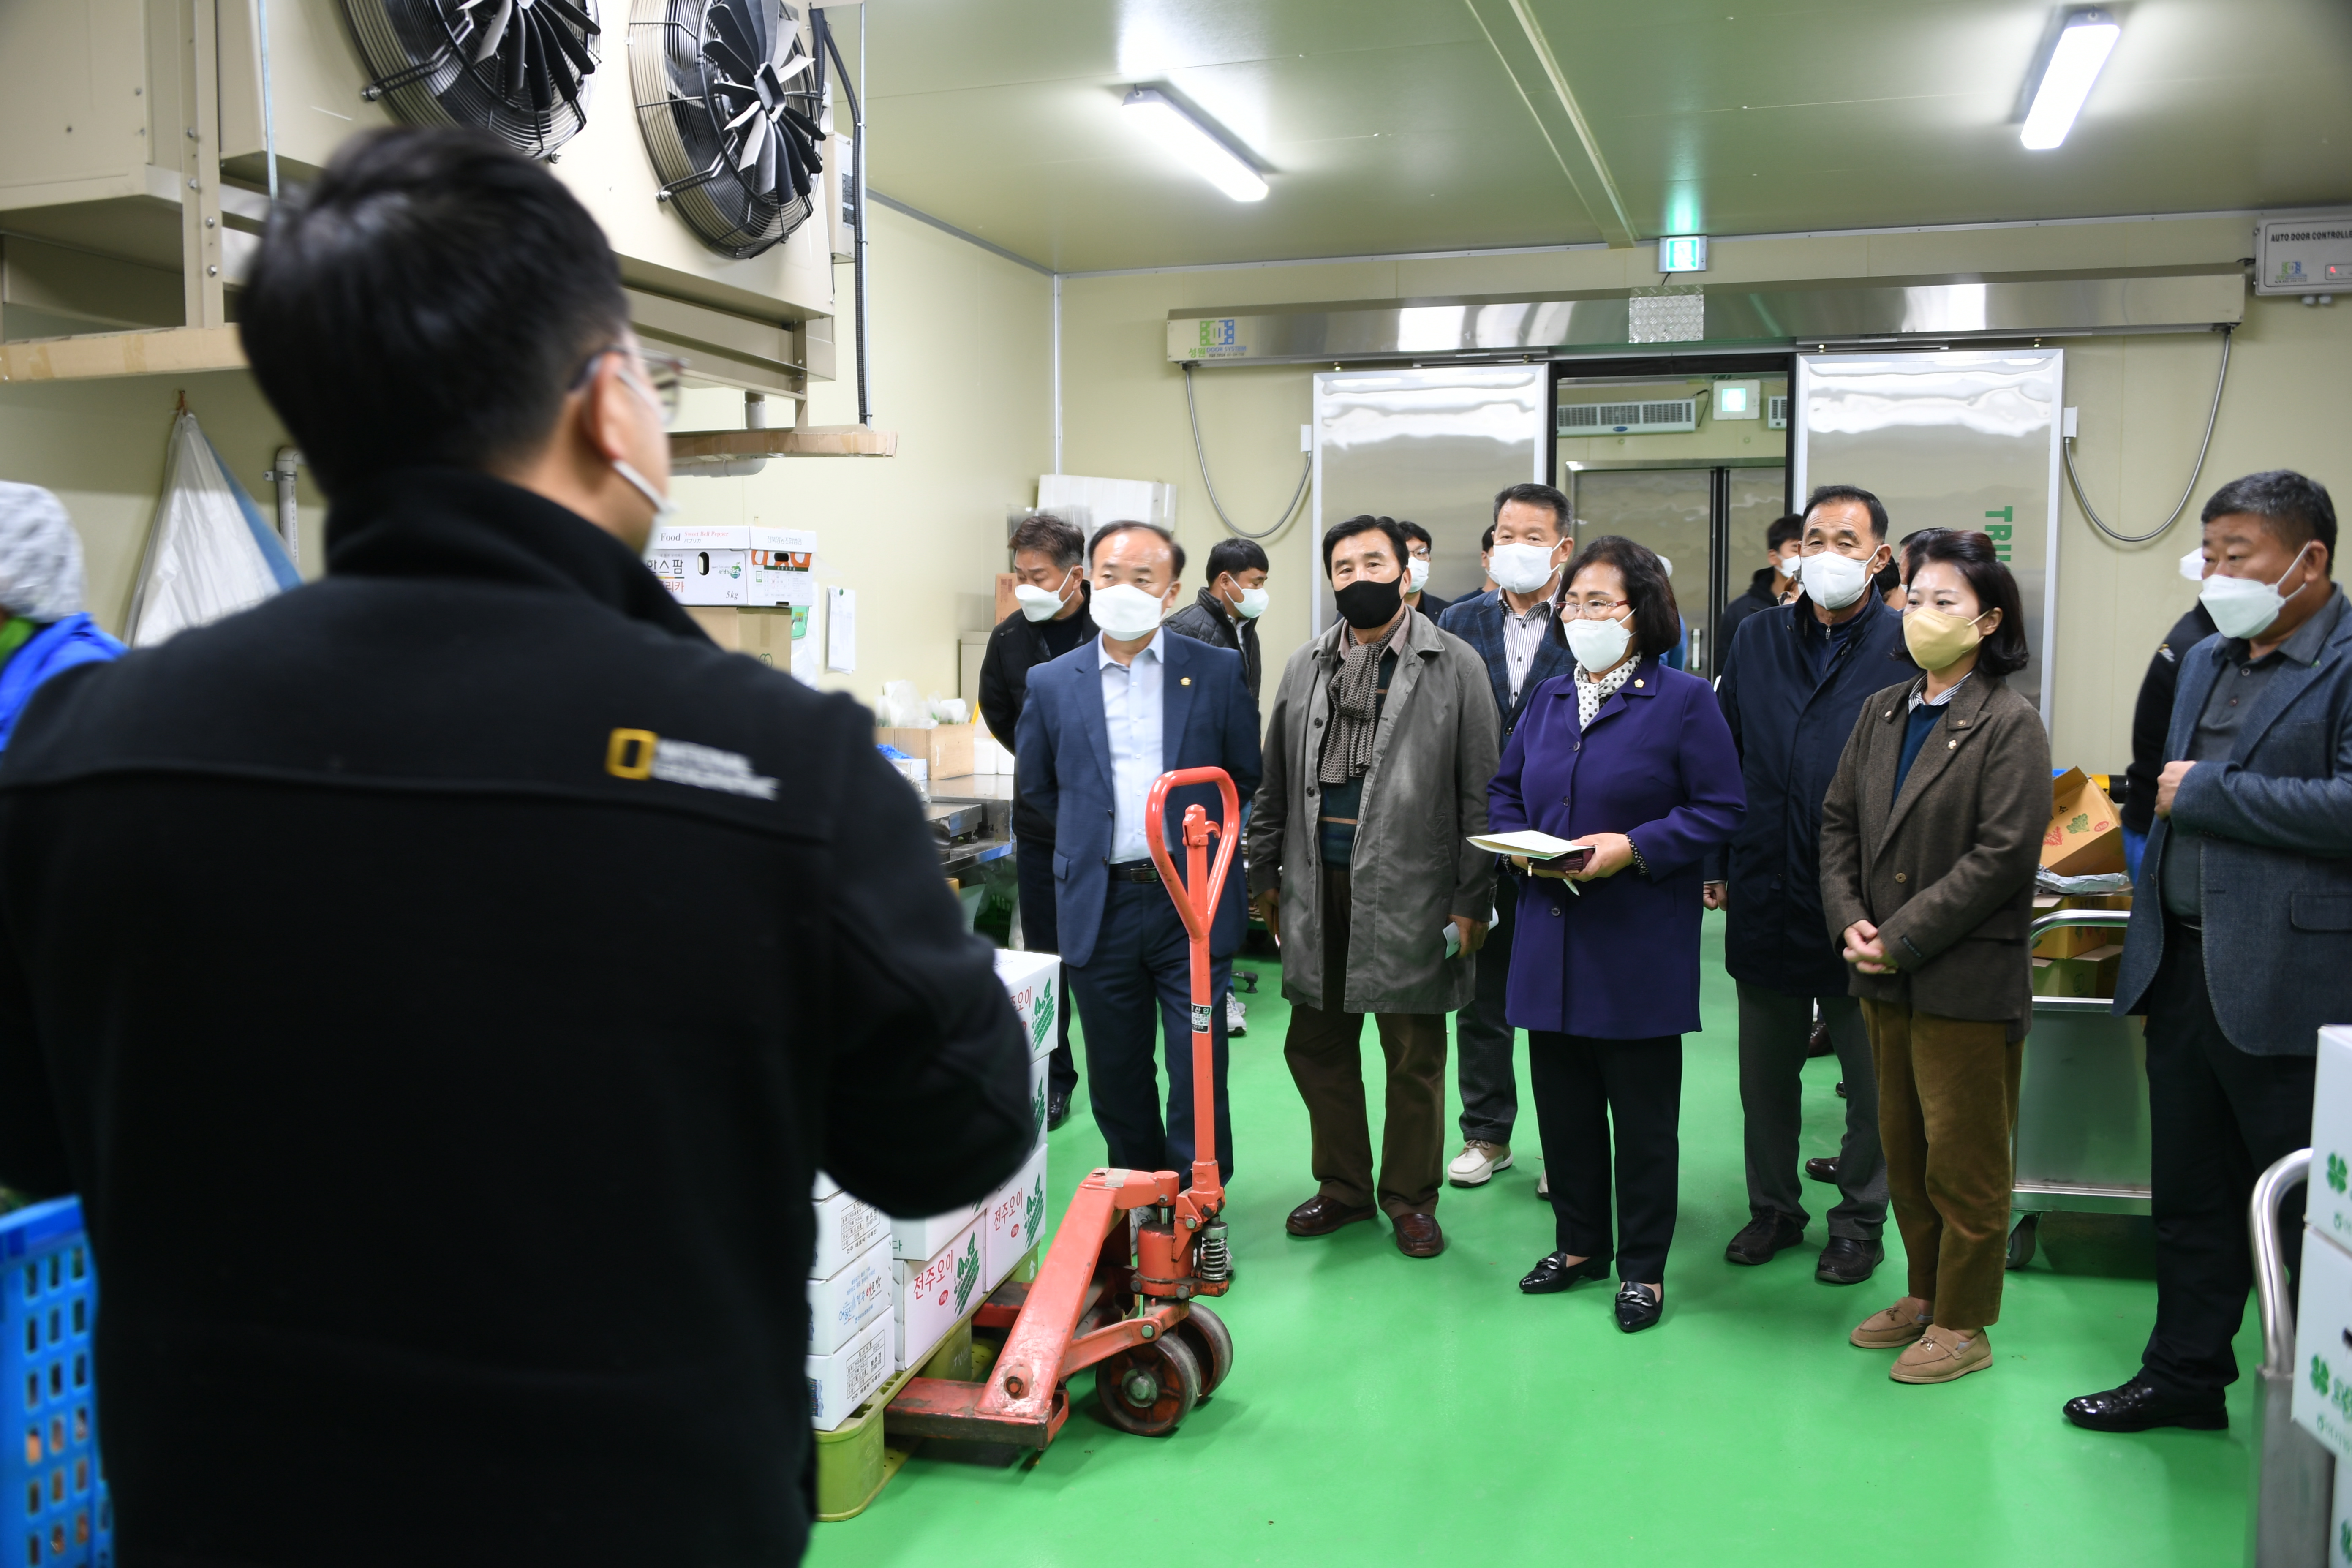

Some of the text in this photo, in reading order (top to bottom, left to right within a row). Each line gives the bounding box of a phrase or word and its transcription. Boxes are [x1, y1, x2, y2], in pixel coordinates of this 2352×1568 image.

[2271, 234, 2289, 242] AUTO
[2291, 233, 2310, 241] DOOR
[661, 533, 681, 541] Food
[994, 1187, 1022, 1231] 전주오이
[914, 1249, 953, 1300] 전주오이
